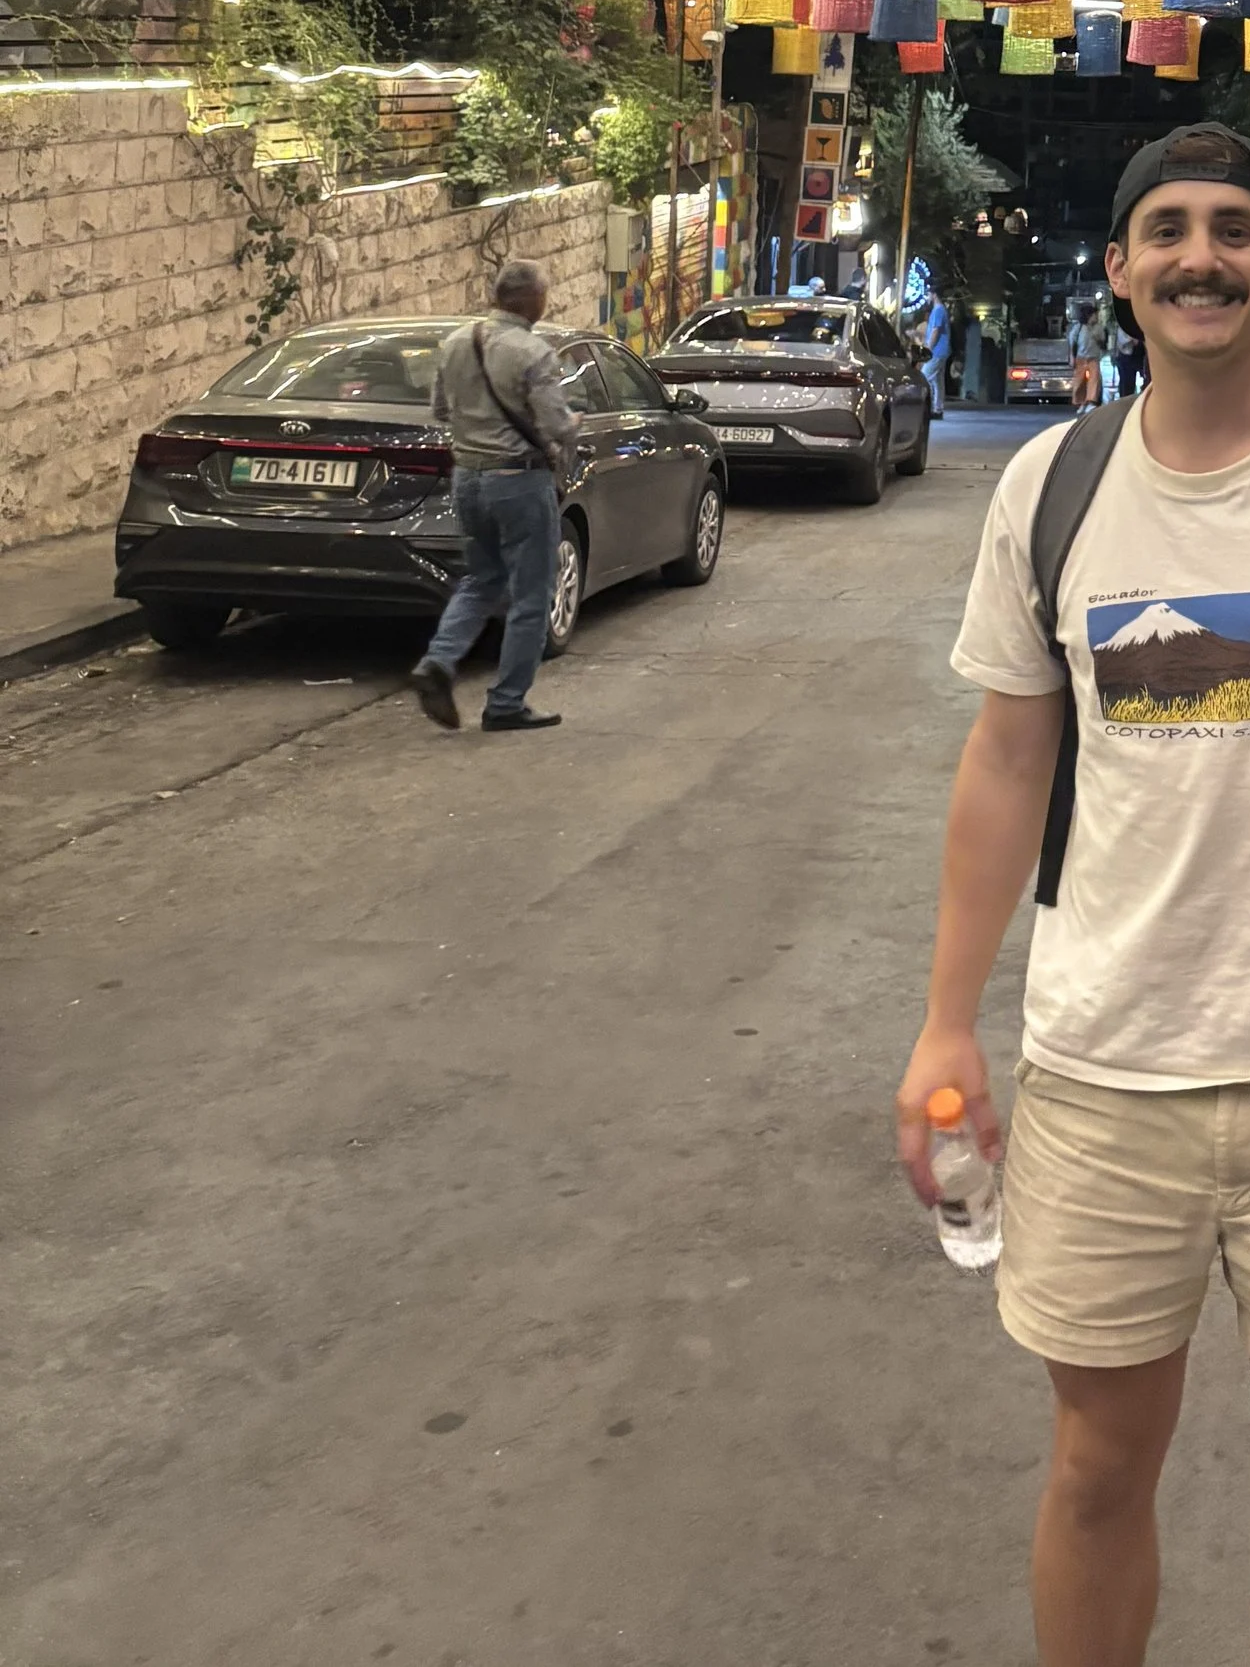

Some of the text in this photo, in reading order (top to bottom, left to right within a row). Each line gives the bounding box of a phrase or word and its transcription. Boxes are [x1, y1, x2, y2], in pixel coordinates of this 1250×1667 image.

[283, 424, 304, 435] KIA
[1088, 587, 1159, 604] Ecuador
[1104, 724, 1224, 739] COTOPAXI
